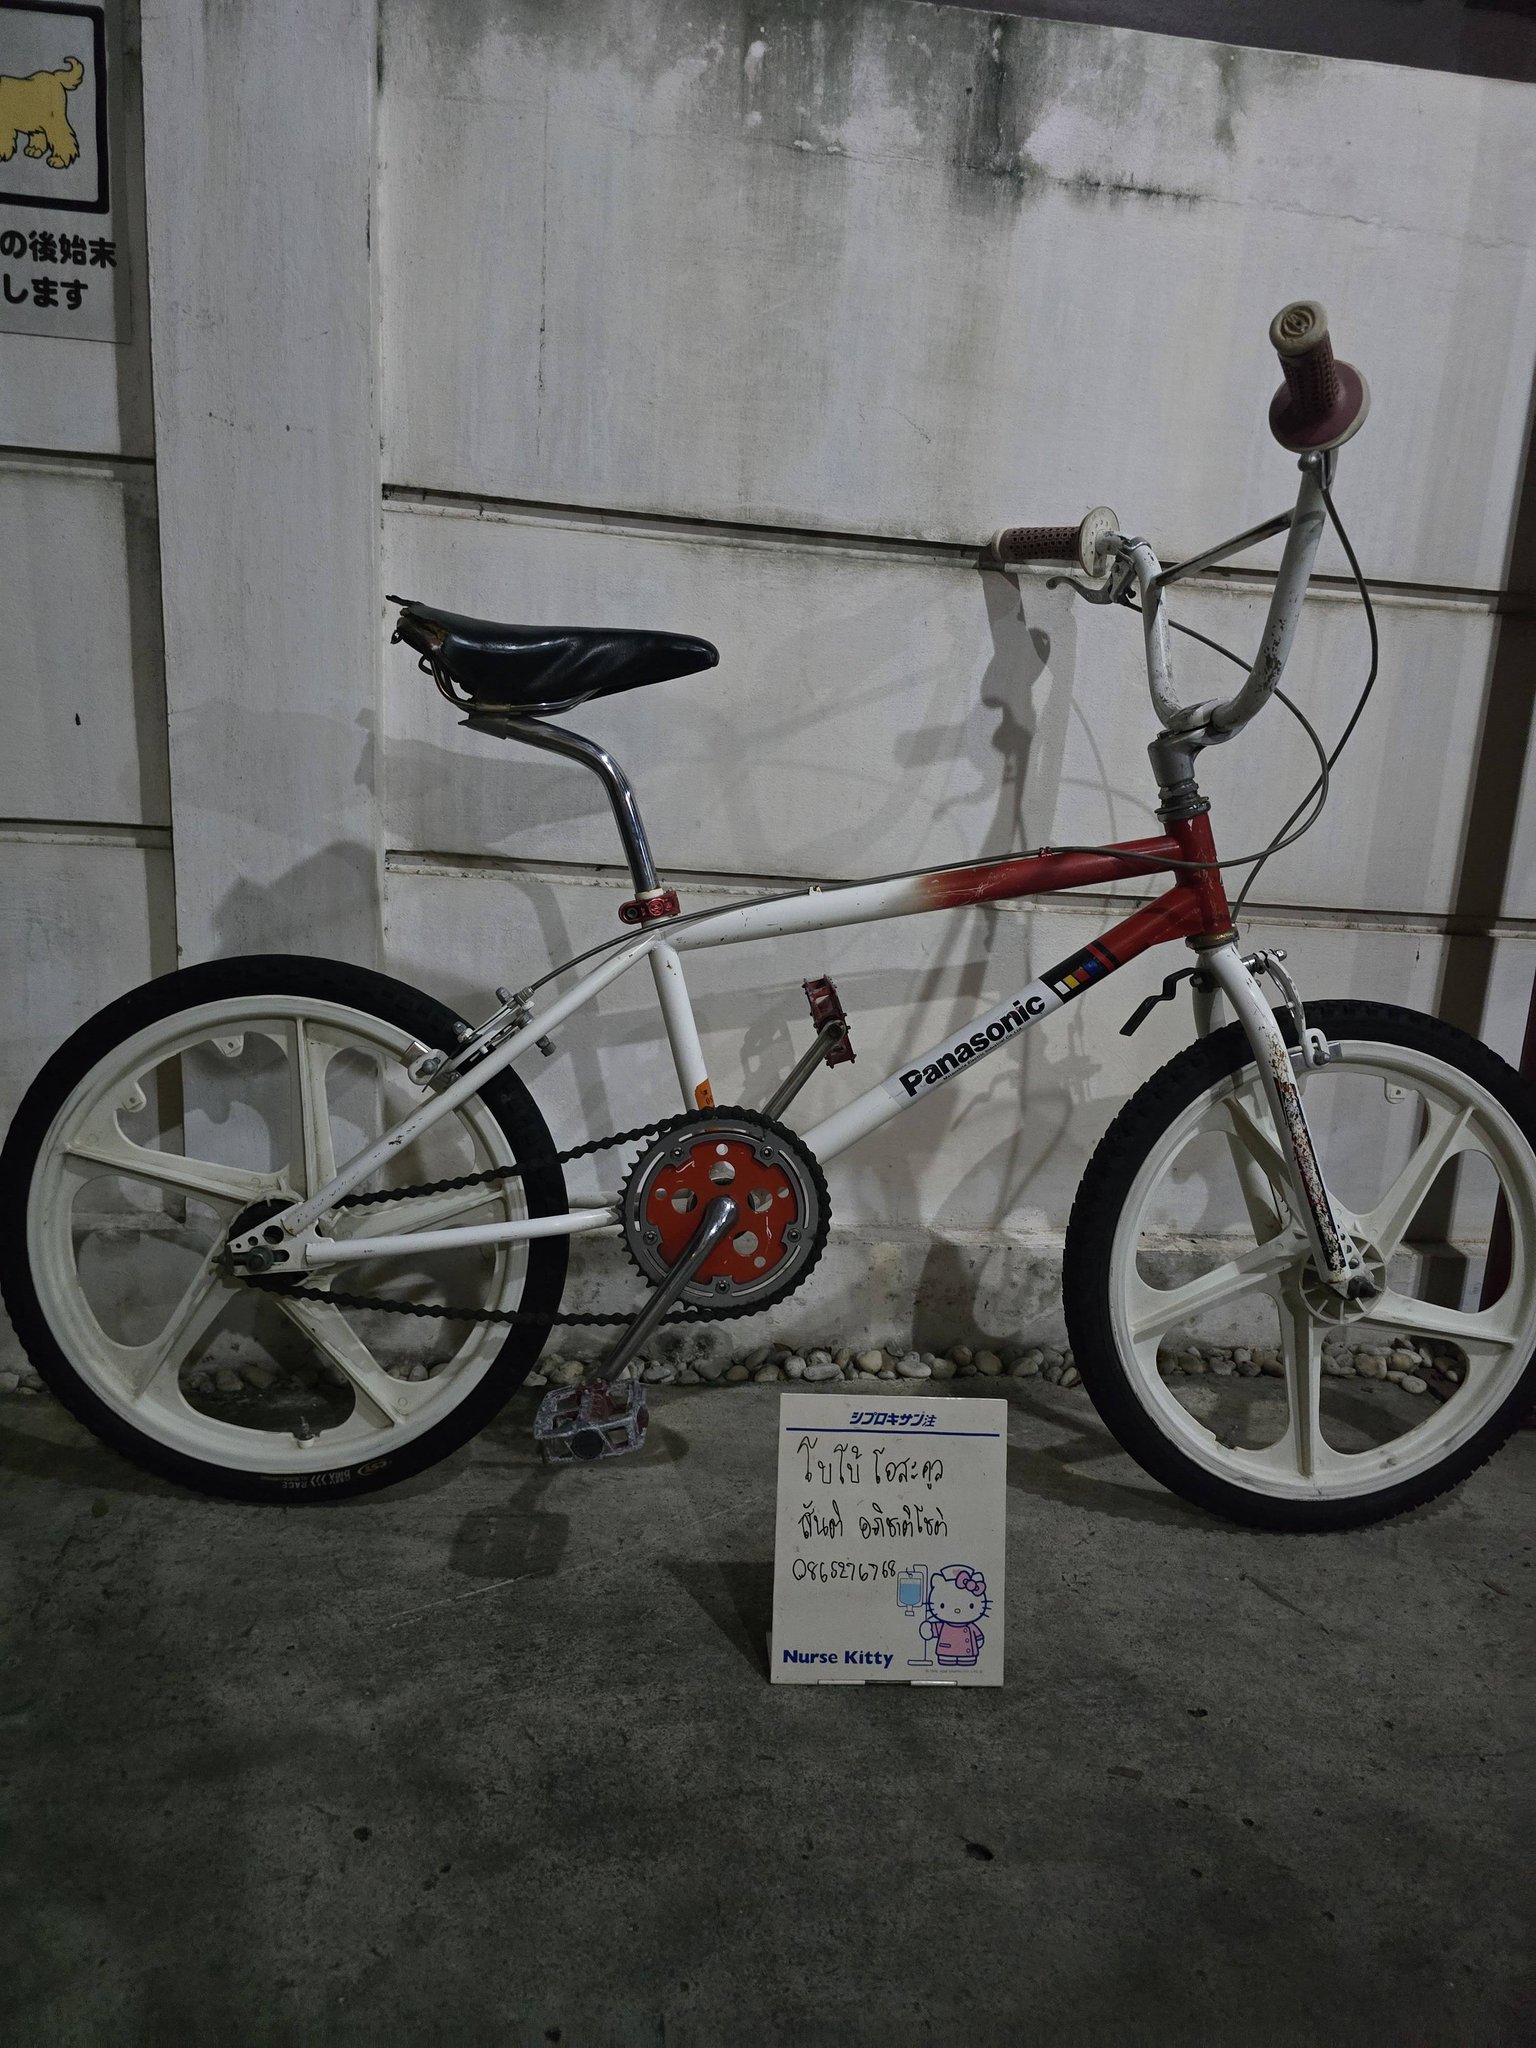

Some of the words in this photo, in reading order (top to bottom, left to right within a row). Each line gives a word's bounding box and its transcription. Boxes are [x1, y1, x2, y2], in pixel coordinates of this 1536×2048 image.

[0, 230, 117, 268] の後始末
[3, 274, 88, 310] します
[899, 995, 1045, 1097] Panasonic
[850, 1411, 937, 1427] シプロキサン注
[281, 1480, 307, 1489] RACE
[328, 1469, 351, 1486] BMX
[783, 1650, 838, 1664] Nurse
[844, 1650, 894, 1669] Kitty
